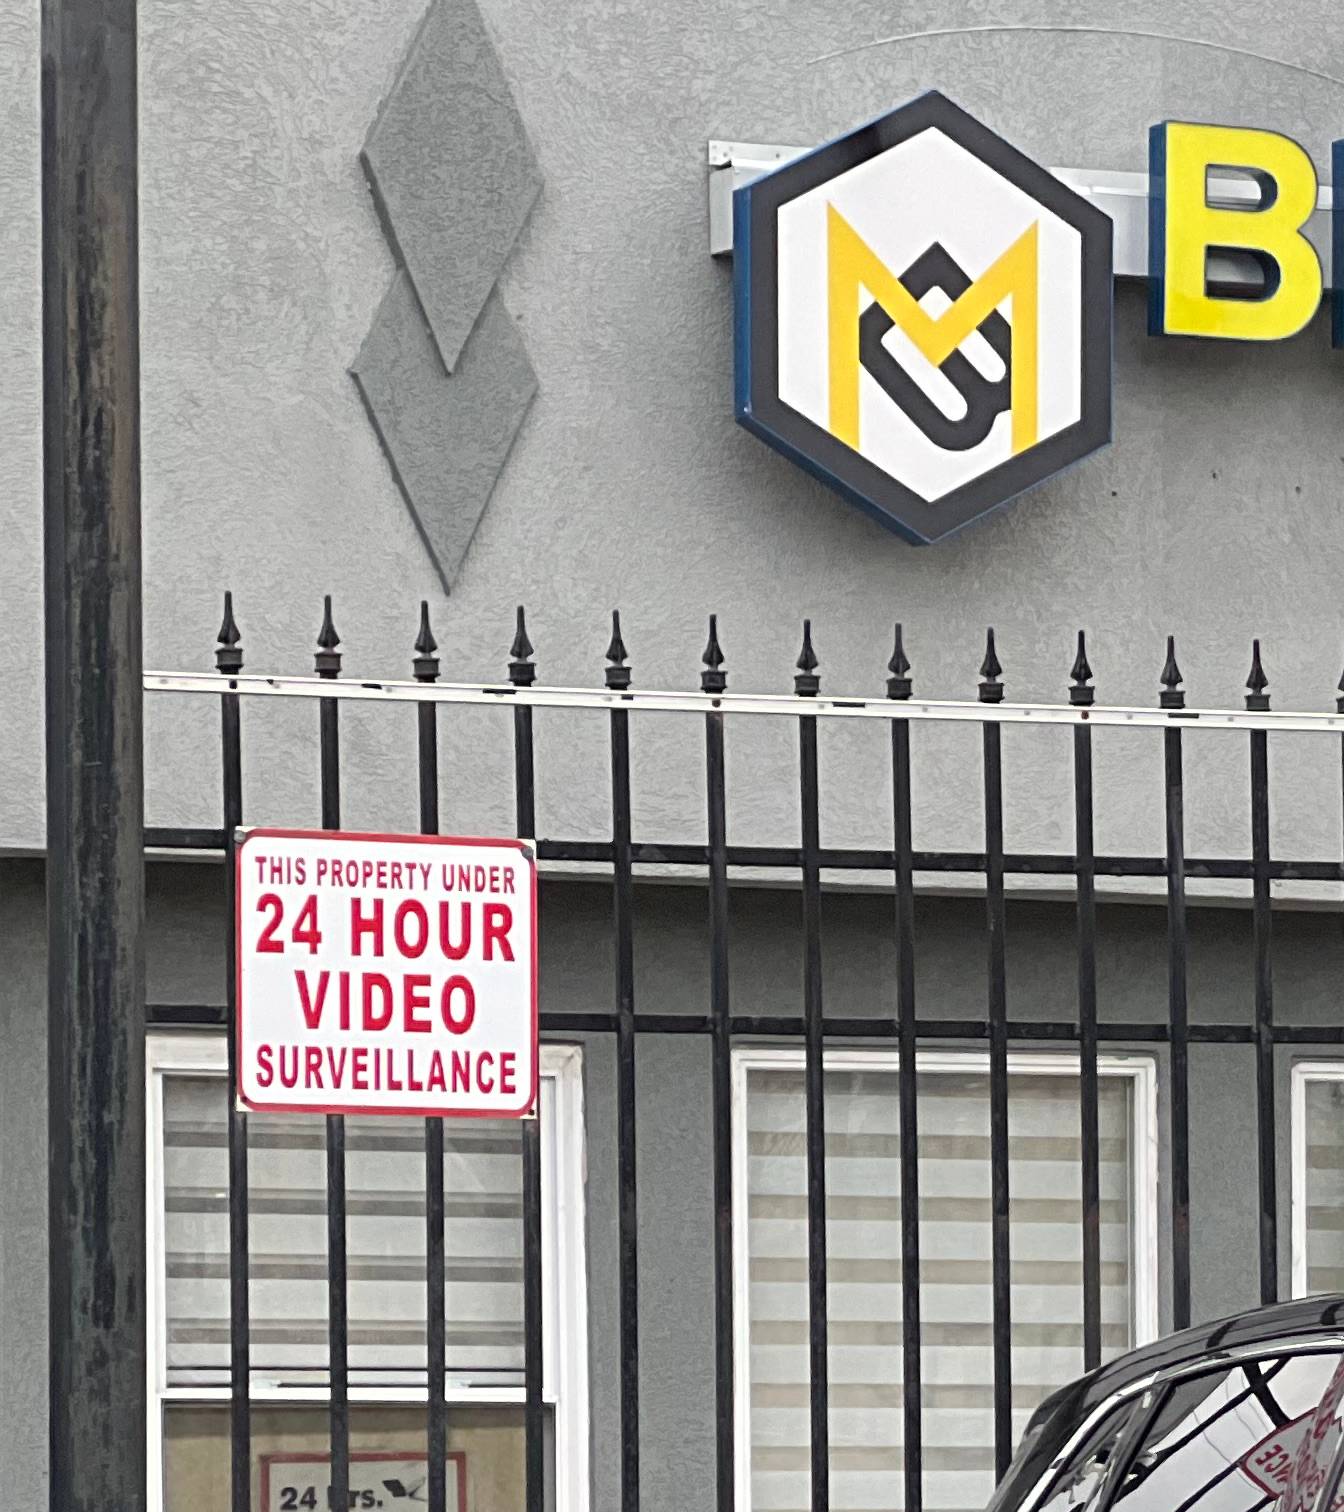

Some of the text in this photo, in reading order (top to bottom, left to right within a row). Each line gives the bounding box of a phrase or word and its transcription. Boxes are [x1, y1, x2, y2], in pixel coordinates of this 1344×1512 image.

[255, 856, 515, 894] THIS PROPERTY UNDER
[255, 893, 515, 962] 24 HOUR
[294, 969, 476, 1035] VIDEO
[255, 1043, 516, 1095] SURVEILLANCE
[280, 1486, 317, 1511] 24
